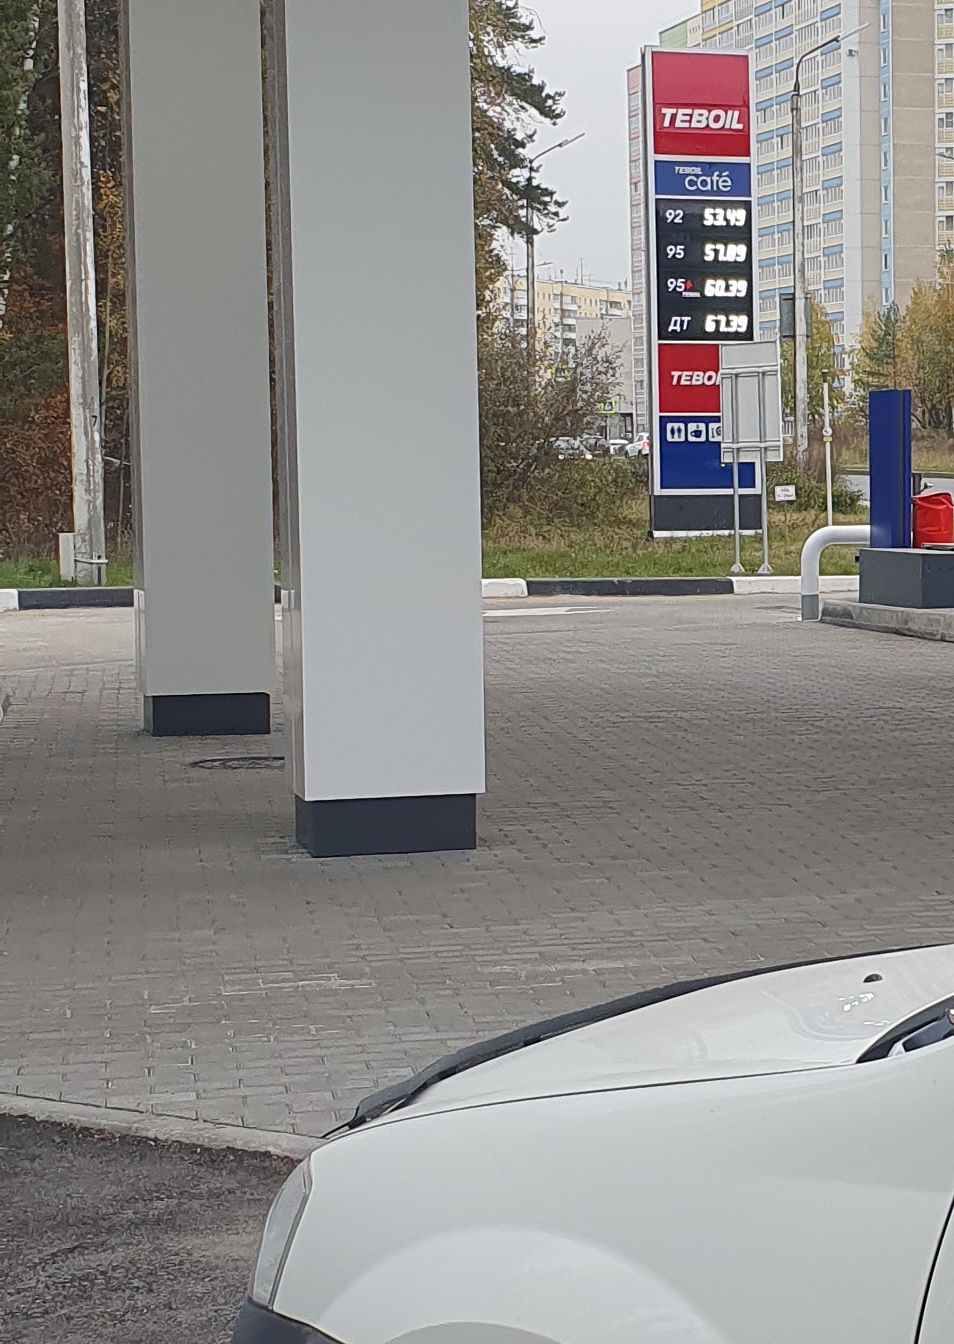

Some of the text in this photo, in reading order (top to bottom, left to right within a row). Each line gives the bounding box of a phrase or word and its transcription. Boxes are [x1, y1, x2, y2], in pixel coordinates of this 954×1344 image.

[661, 108, 744, 130] TEBOIL
[684, 171, 732, 191] café
[666, 208, 747, 226] 92 53.49
[666, 245, 685, 259] 95
[667, 278, 748, 297] 95 60.39
[668, 314, 748, 332] ДТ 67.39
